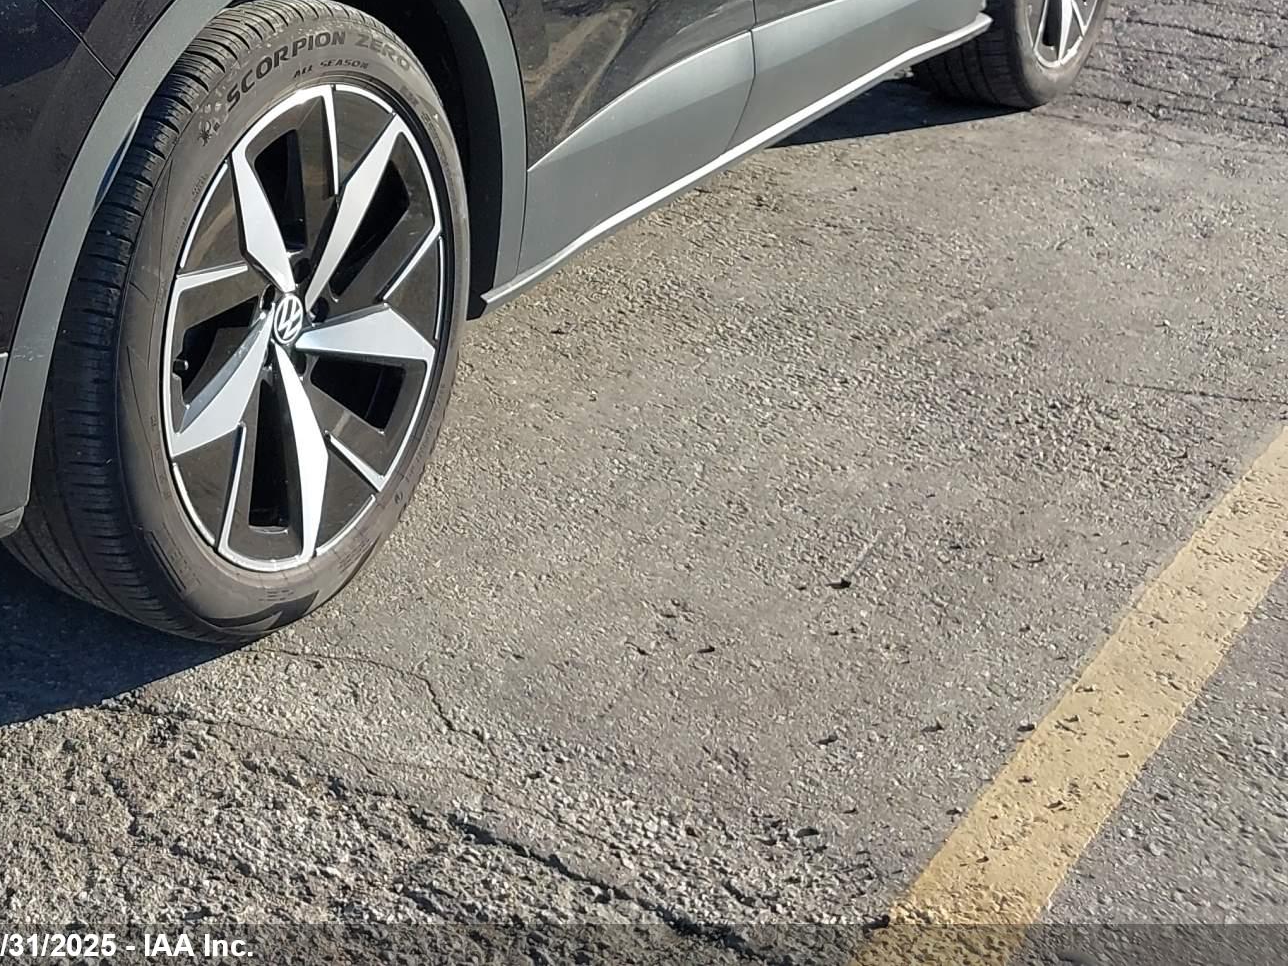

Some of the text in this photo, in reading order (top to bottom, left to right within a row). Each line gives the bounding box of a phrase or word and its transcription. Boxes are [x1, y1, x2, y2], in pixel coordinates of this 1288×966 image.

[226, 30, 412, 113] SCORPION ZERO
[293, 58, 370, 79] ALL SEASON
